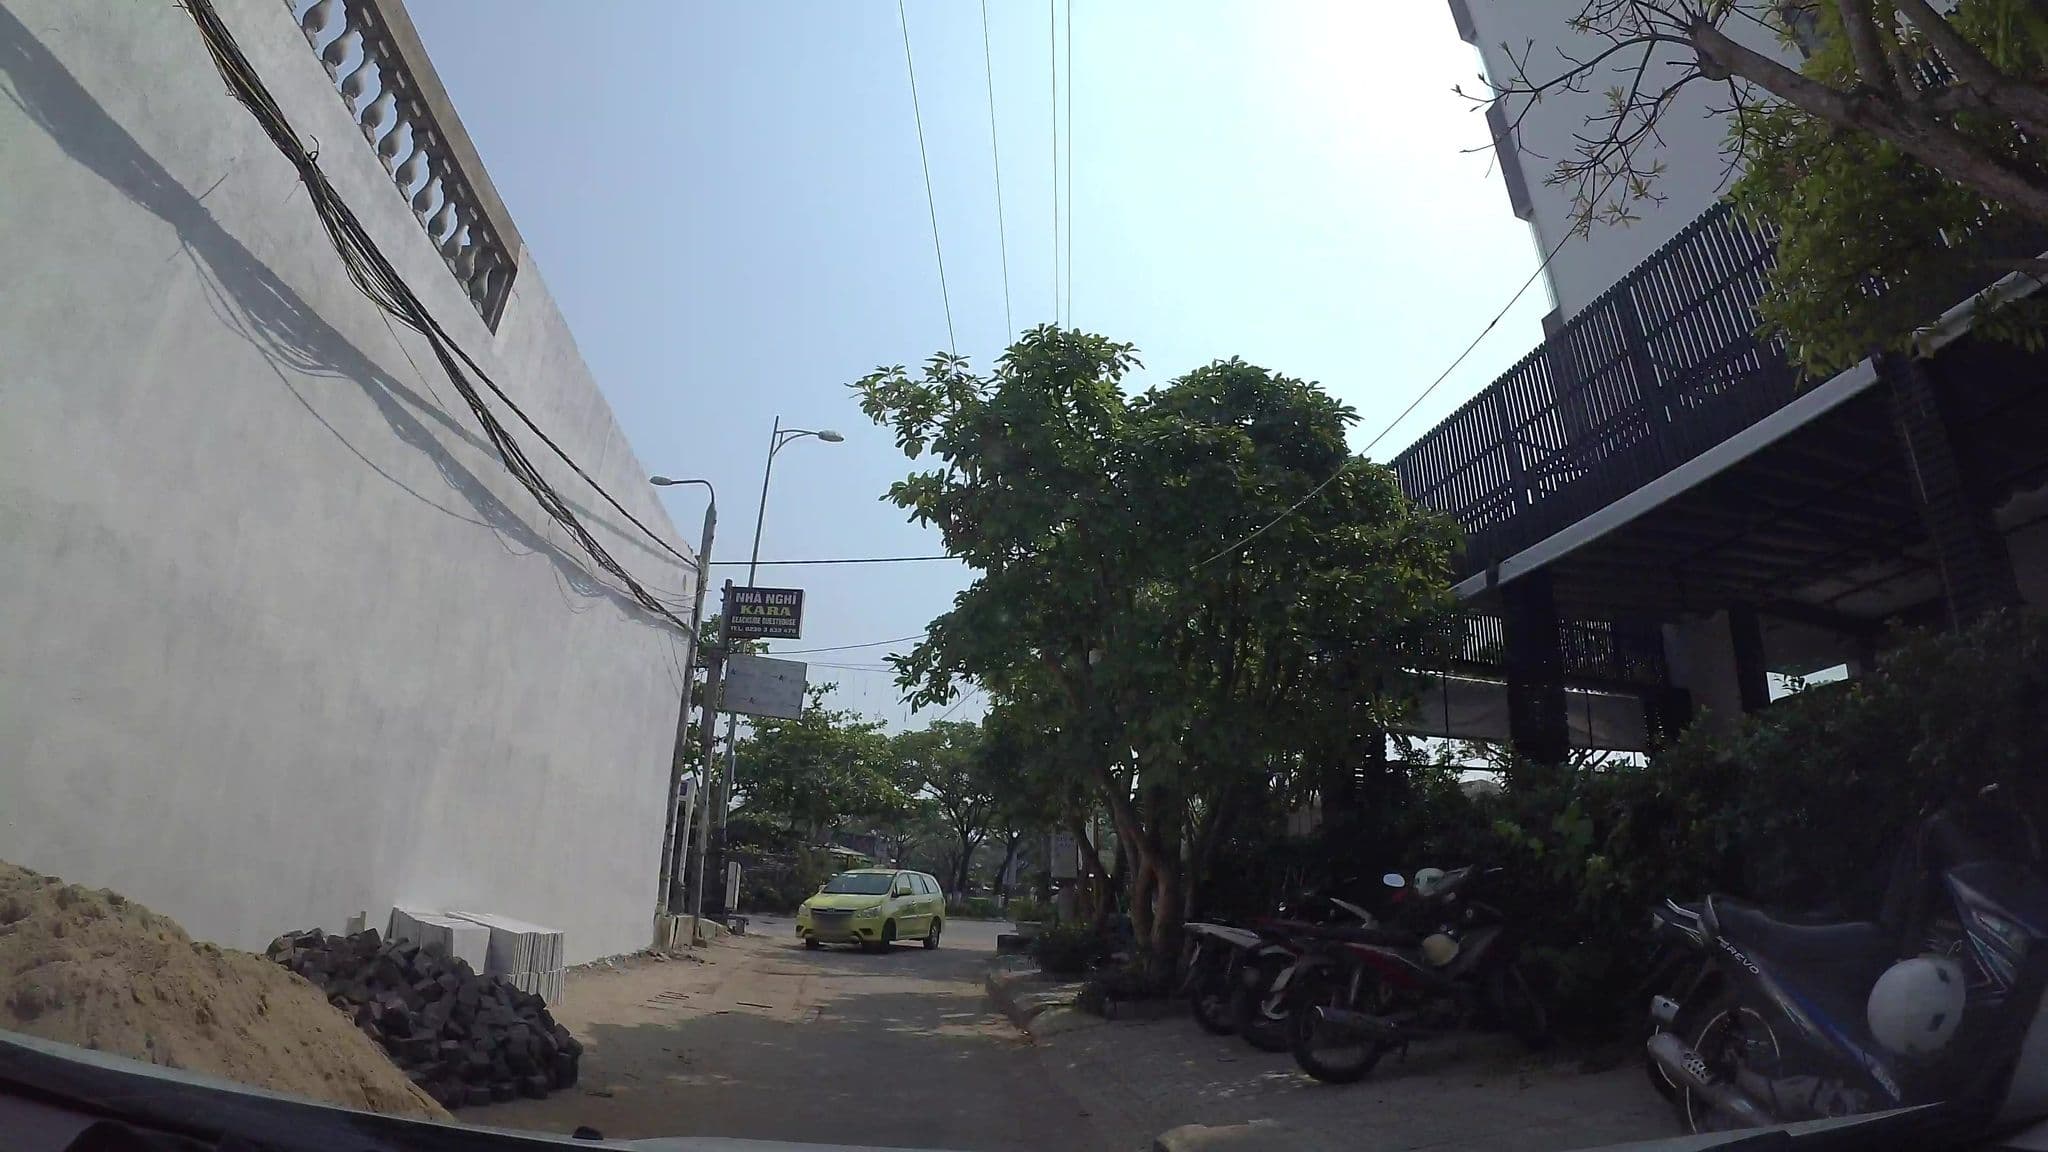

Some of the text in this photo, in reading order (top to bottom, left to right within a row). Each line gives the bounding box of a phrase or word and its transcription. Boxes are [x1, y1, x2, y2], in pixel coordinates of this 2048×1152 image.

[740, 605, 791, 616] KARA
[762, 617, 796, 626] GUESTHOUSE
[1726, 945, 1760, 974] REVO
